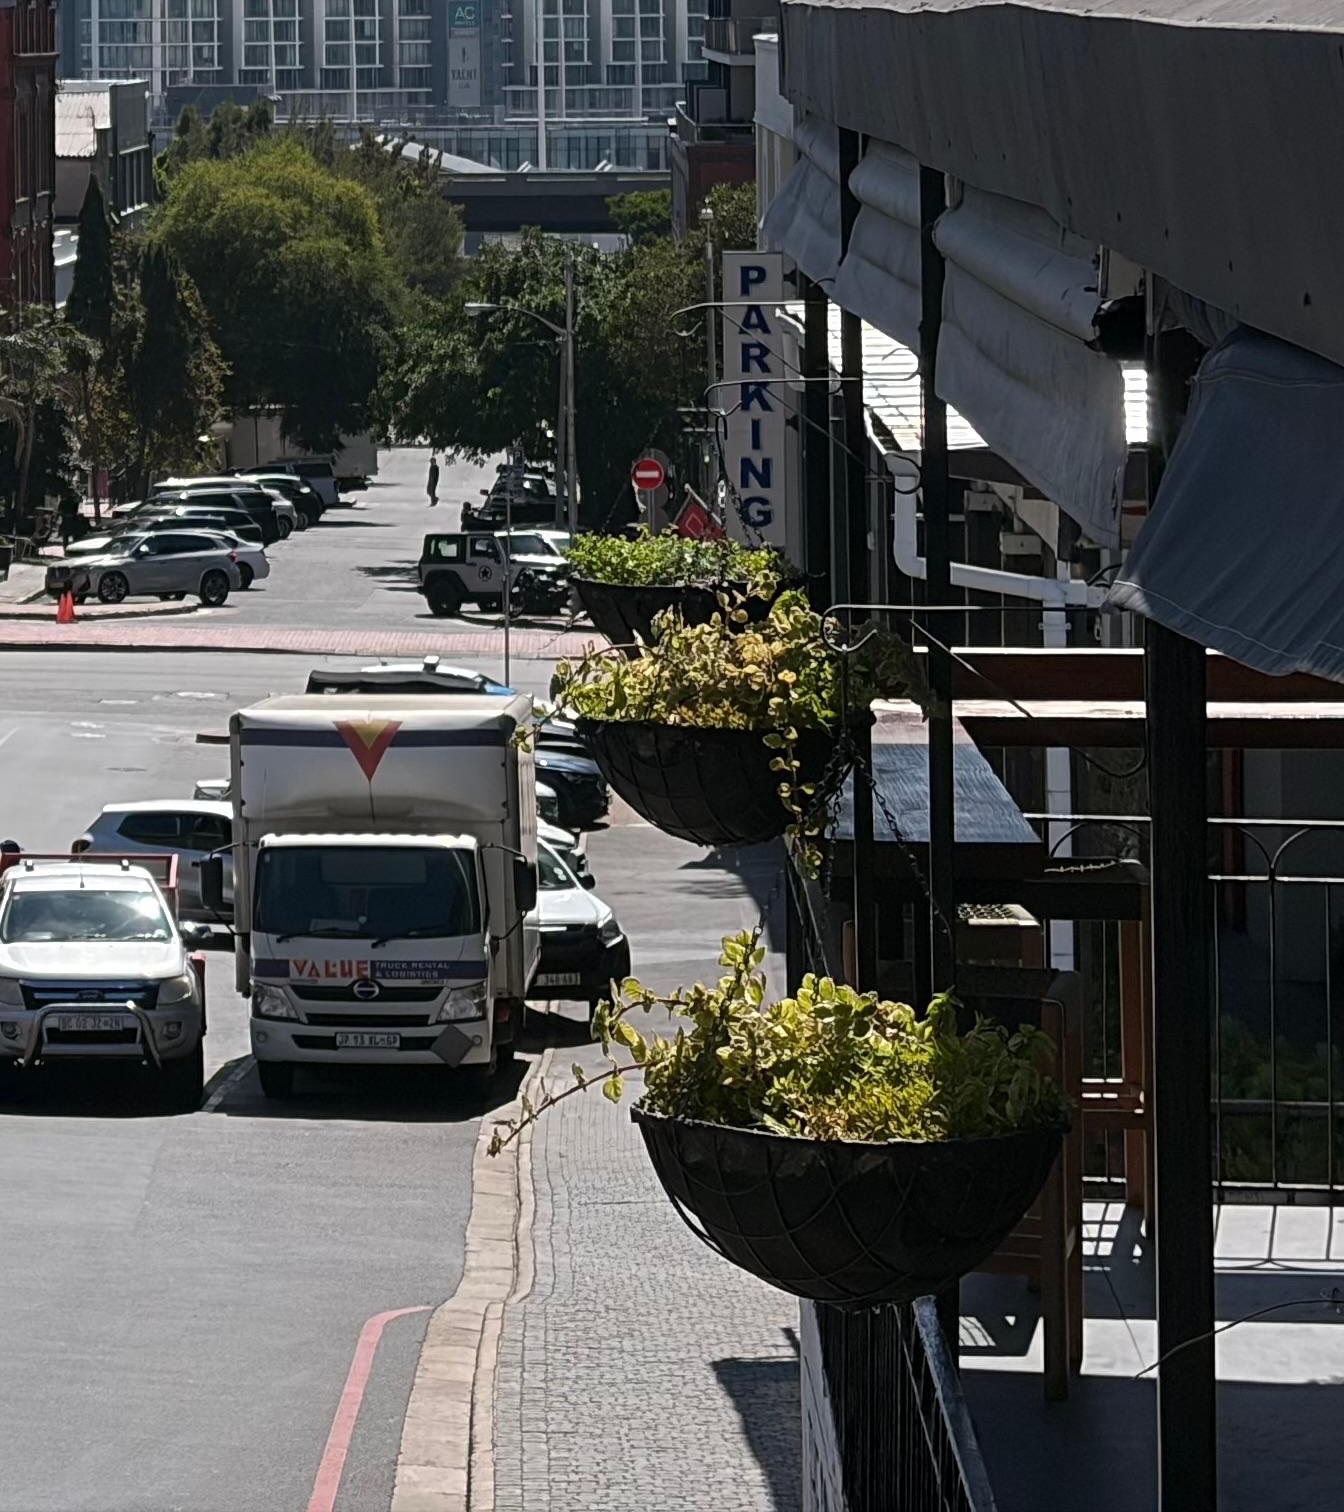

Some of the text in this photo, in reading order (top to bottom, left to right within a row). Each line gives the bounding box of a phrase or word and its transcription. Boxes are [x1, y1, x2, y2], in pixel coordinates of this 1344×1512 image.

[454, 6, 476, 20] AC
[738, 265, 775, 529] PARKING
[291, 959, 370, 979] VALUE
[375, 961, 450, 970] TRUCK RENTAL
